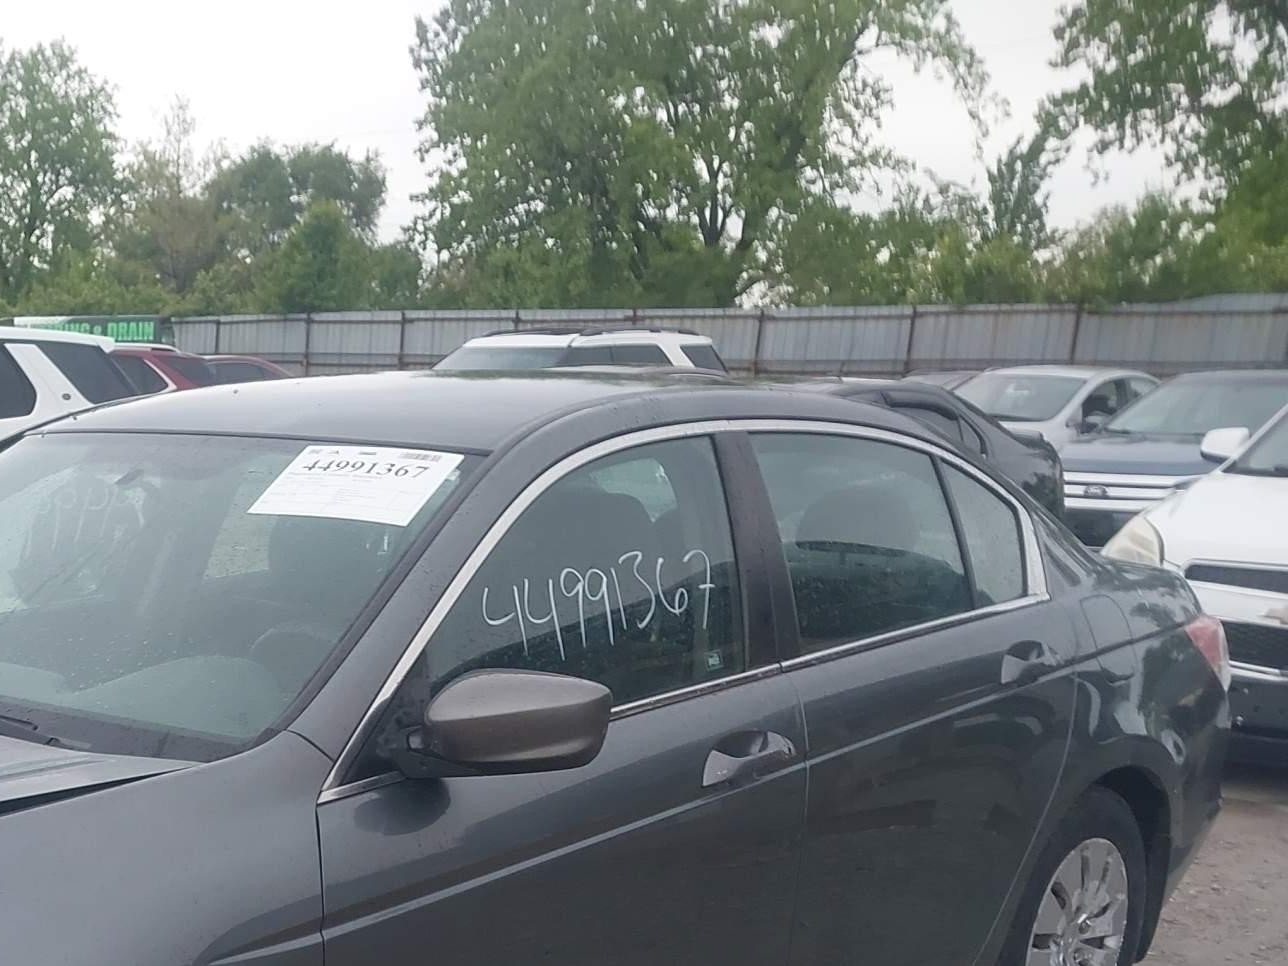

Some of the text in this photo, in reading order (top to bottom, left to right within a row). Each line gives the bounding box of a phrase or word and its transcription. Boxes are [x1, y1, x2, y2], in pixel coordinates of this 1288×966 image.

[107, 322, 154, 340] DRAIN
[302, 459, 430, 479] 44991367
[482, 550, 715, 661] 44991367
